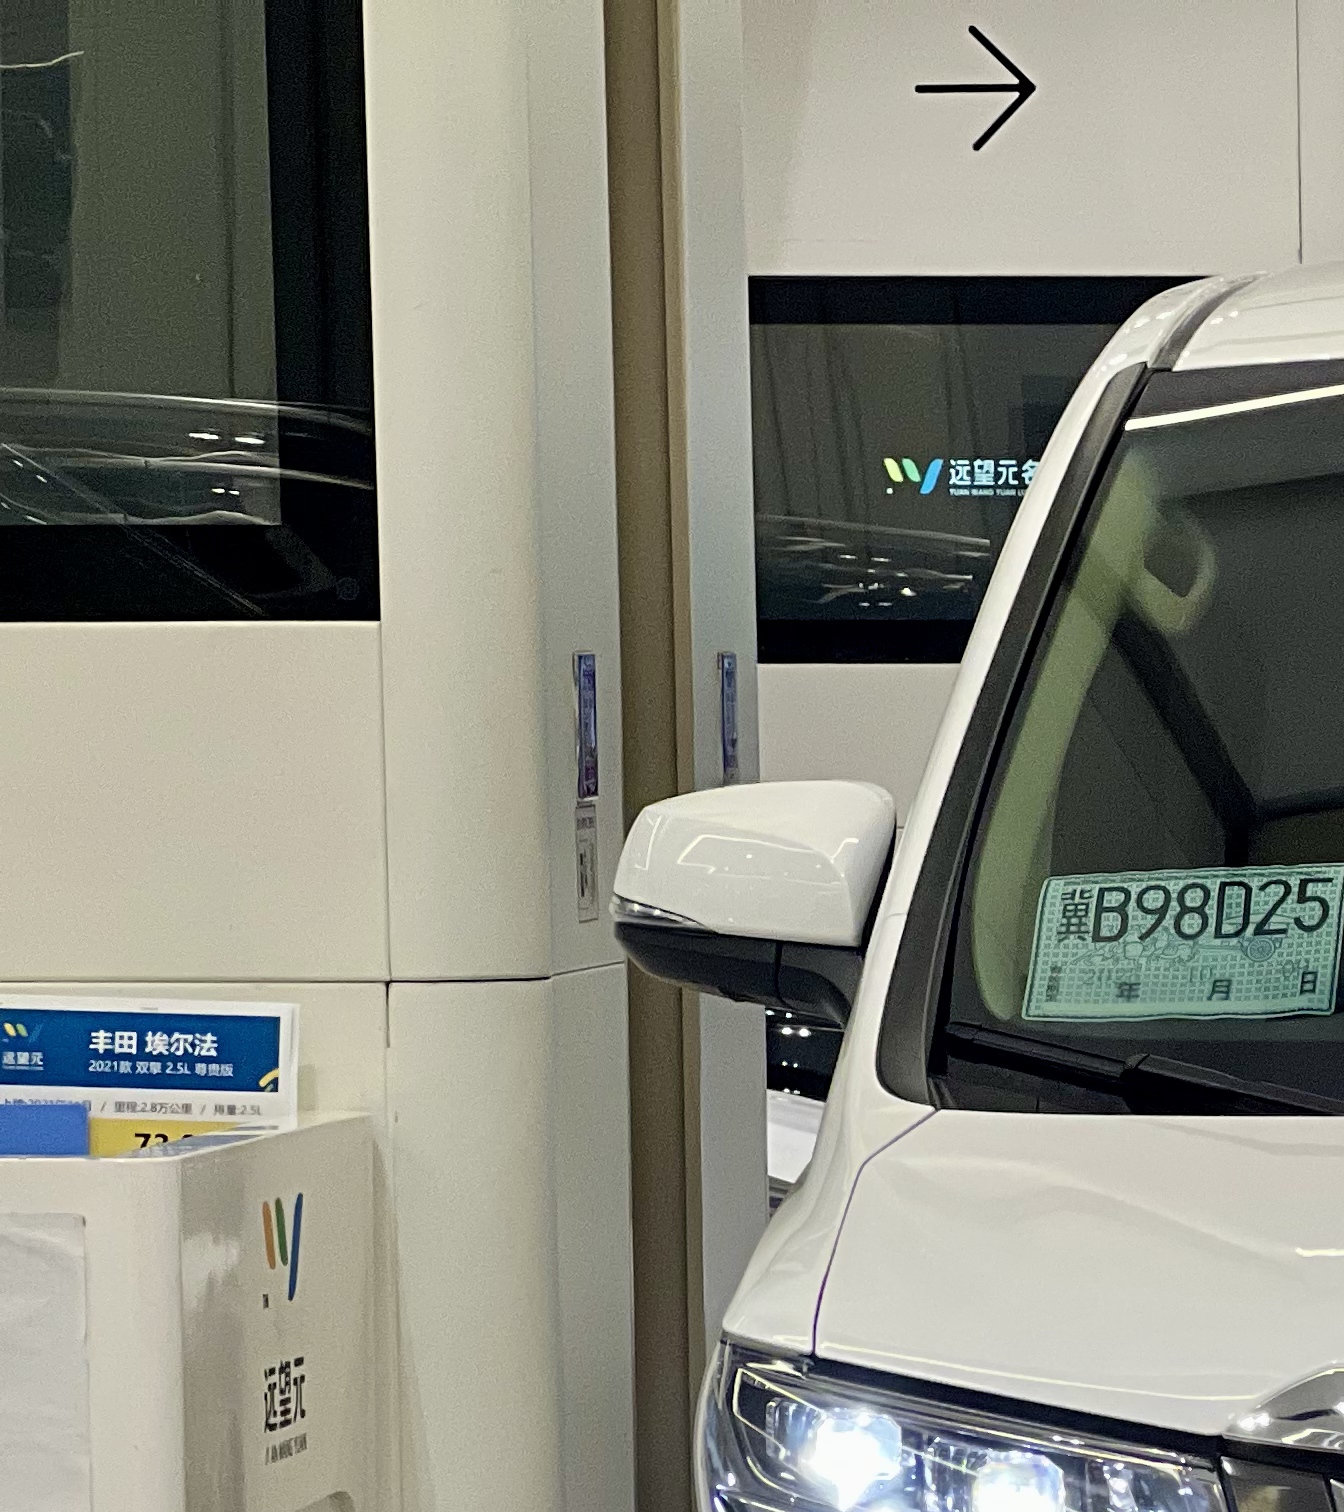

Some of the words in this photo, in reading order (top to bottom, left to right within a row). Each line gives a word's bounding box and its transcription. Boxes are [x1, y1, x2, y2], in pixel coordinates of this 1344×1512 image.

[89, 1030, 138, 1054] 丰田
[145, 1031, 218, 1057] 埃尔法
[88, 1060, 132, 1074] 2021款
[165, 1062, 191, 1075] 2.5L
[264, 1357, 306, 1433] 远望元
